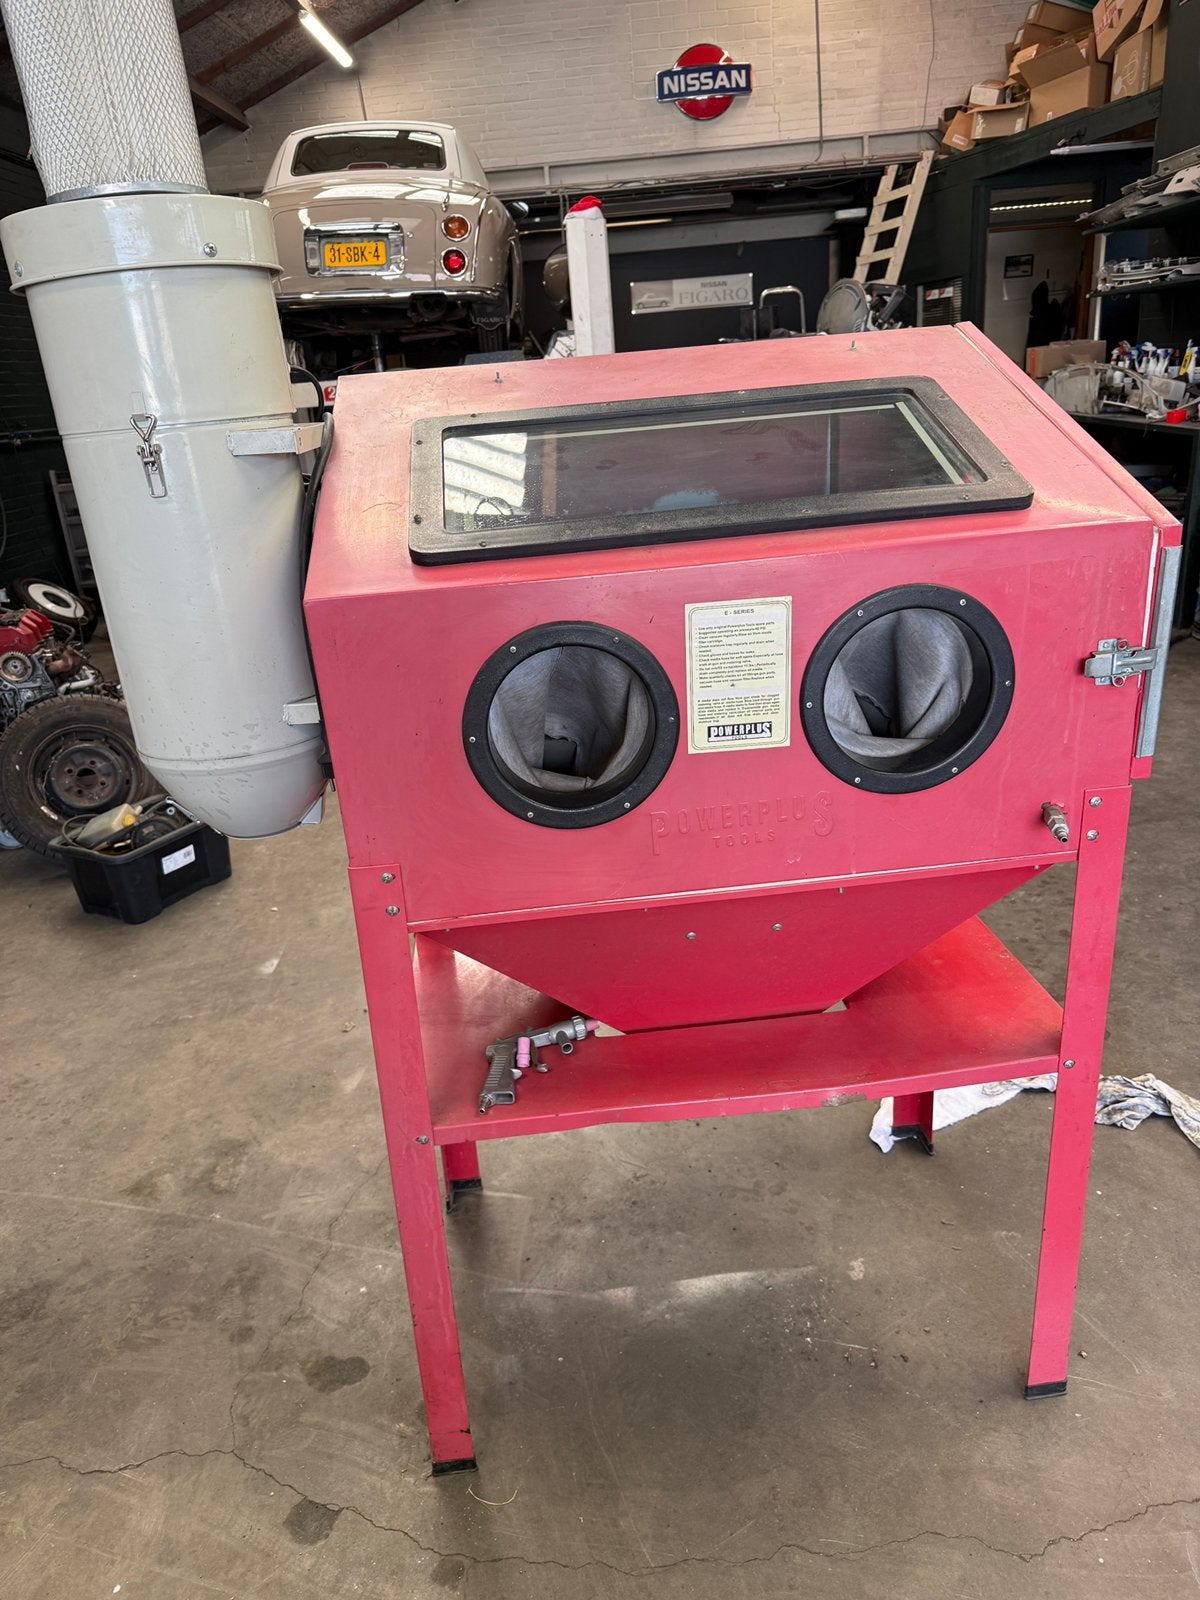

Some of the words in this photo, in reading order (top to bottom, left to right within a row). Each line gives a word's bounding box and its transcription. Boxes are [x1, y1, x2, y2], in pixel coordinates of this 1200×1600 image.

[663, 69, 747, 95] NISSAN
[329, 243, 380, 263] 31-SBK-4
[700, 280, 728, 288] NISSAN
[679, 287, 749, 305] FIGARO
[708, 722, 772, 740] POWERPLUS
[649, 790, 835, 857] POWERPLUS
[711, 828, 777, 849] TOOLS
